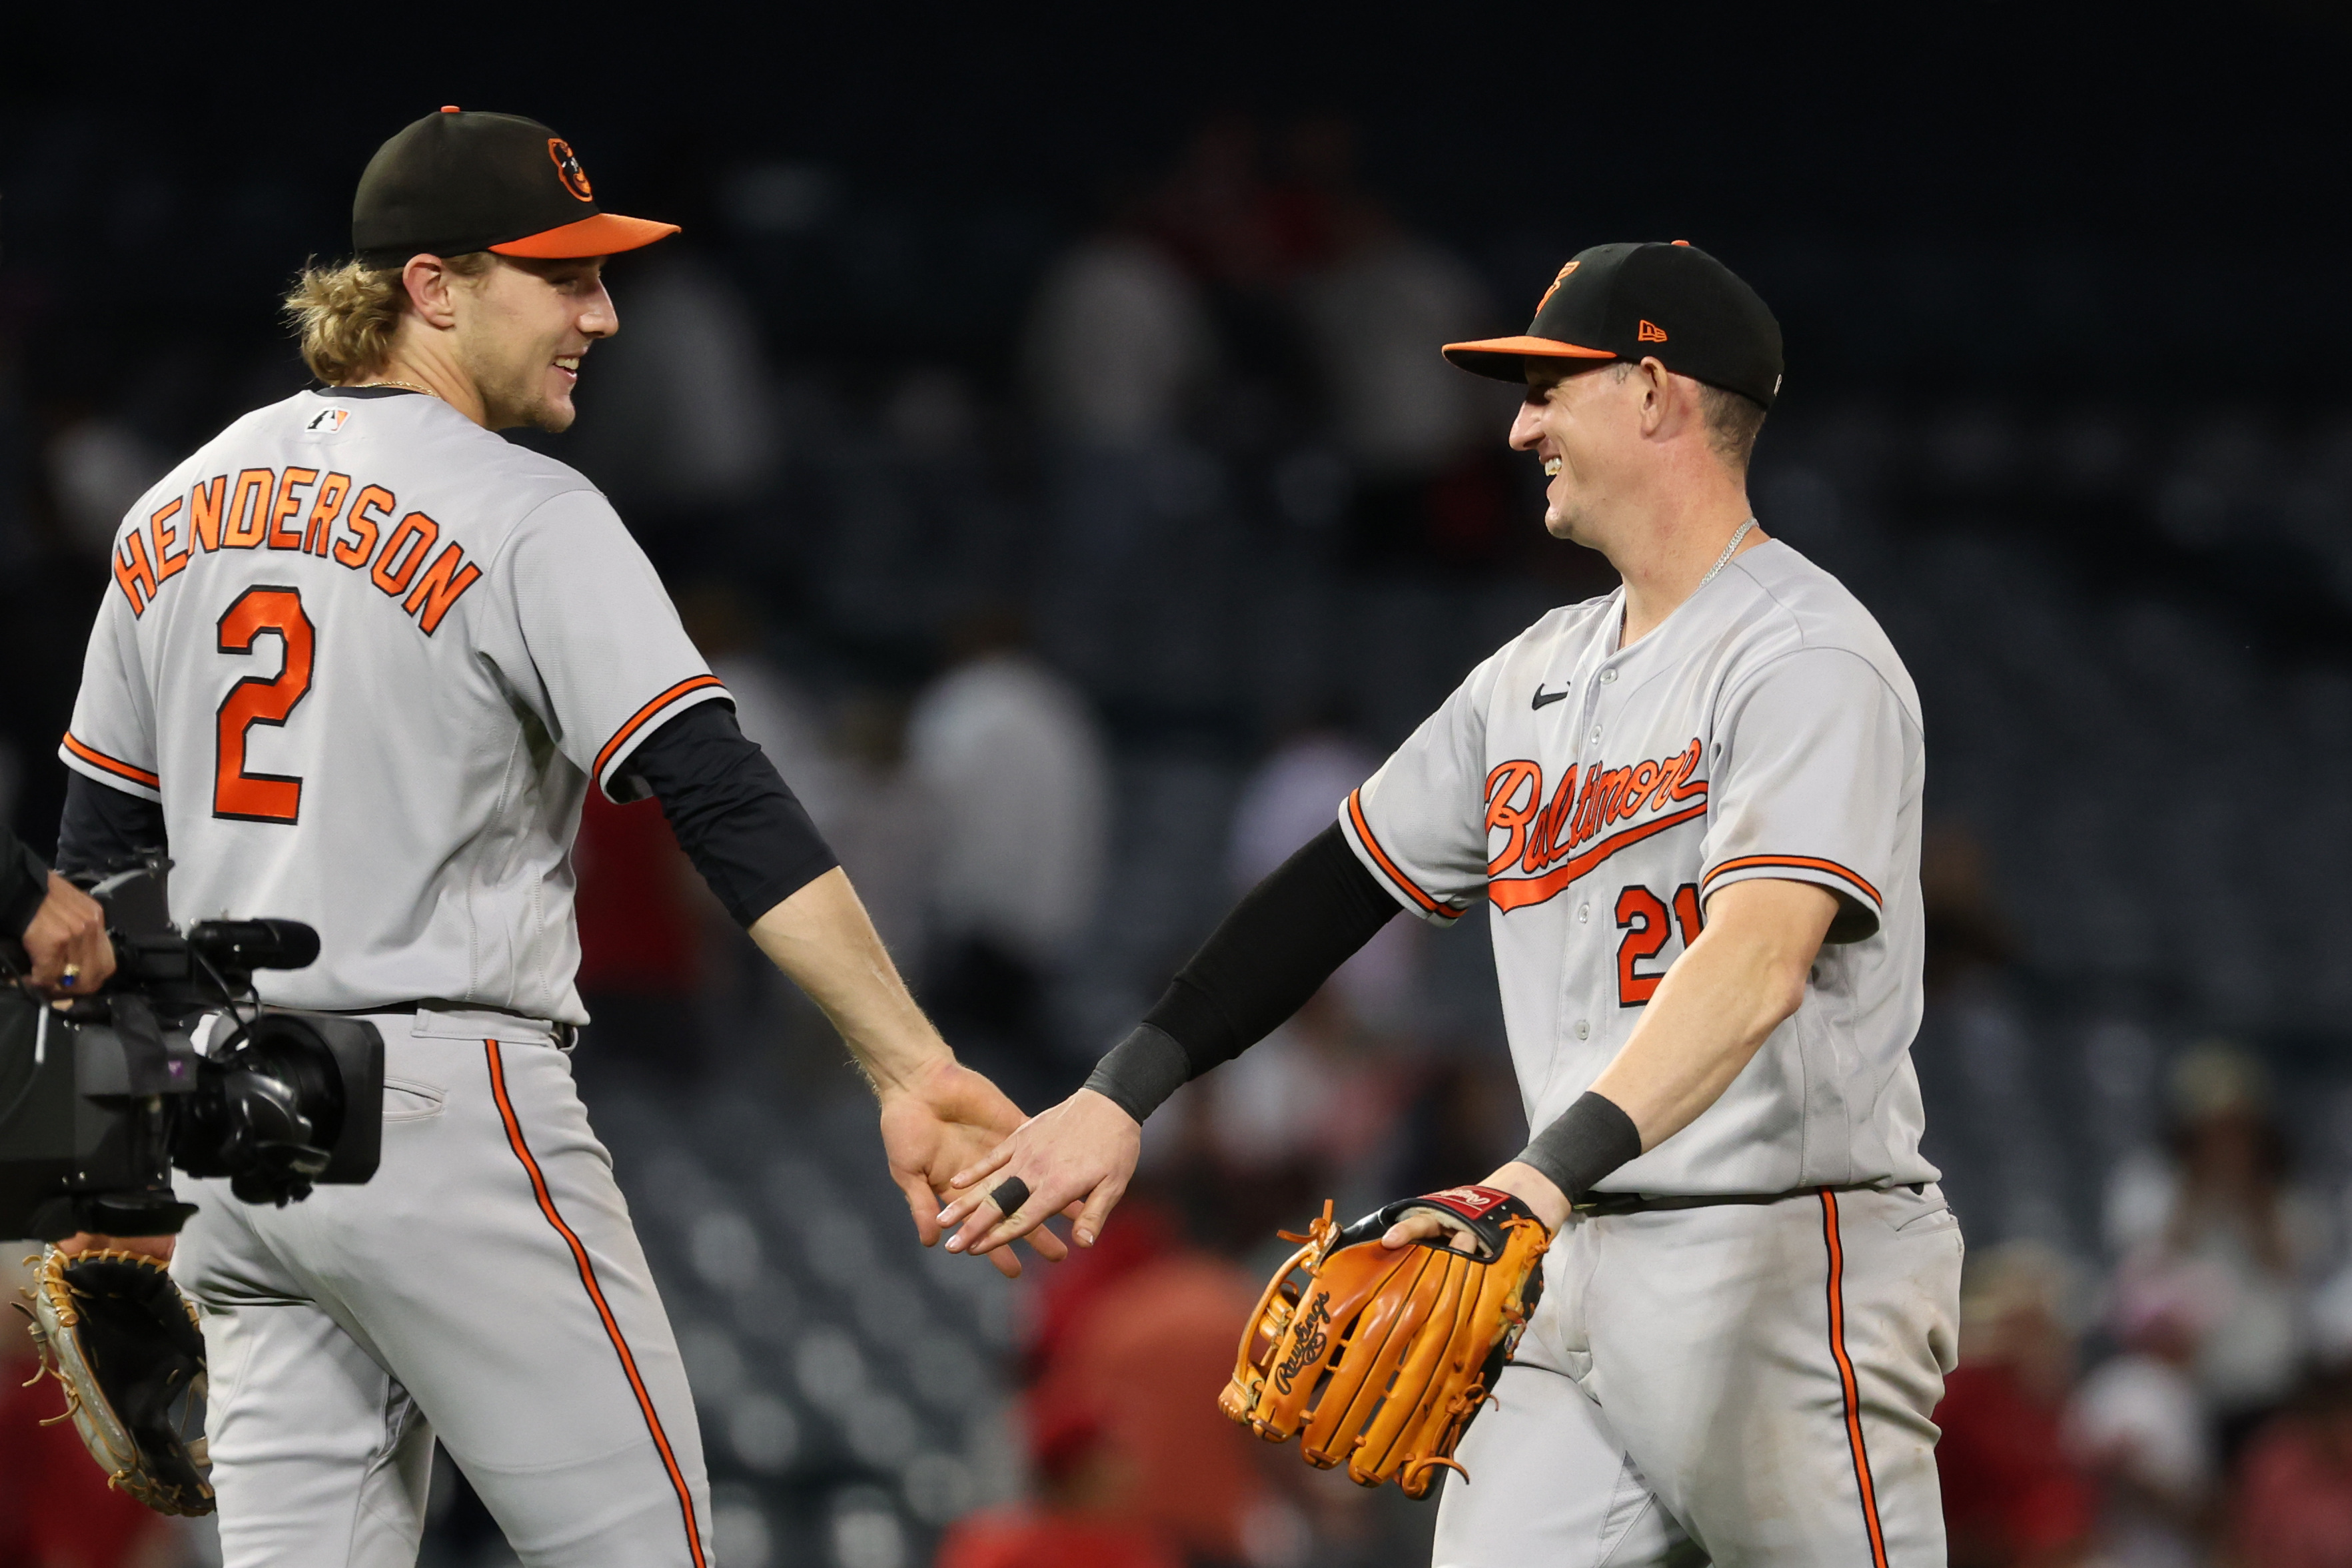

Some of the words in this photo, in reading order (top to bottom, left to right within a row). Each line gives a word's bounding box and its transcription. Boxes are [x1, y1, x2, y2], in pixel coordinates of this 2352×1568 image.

[114, 466, 482, 637] HENDERSON
[213, 584, 315, 825] 2
[1484, 737, 1708, 878] Baltimore
[1275, 1291, 1330, 1395] Rawlings
